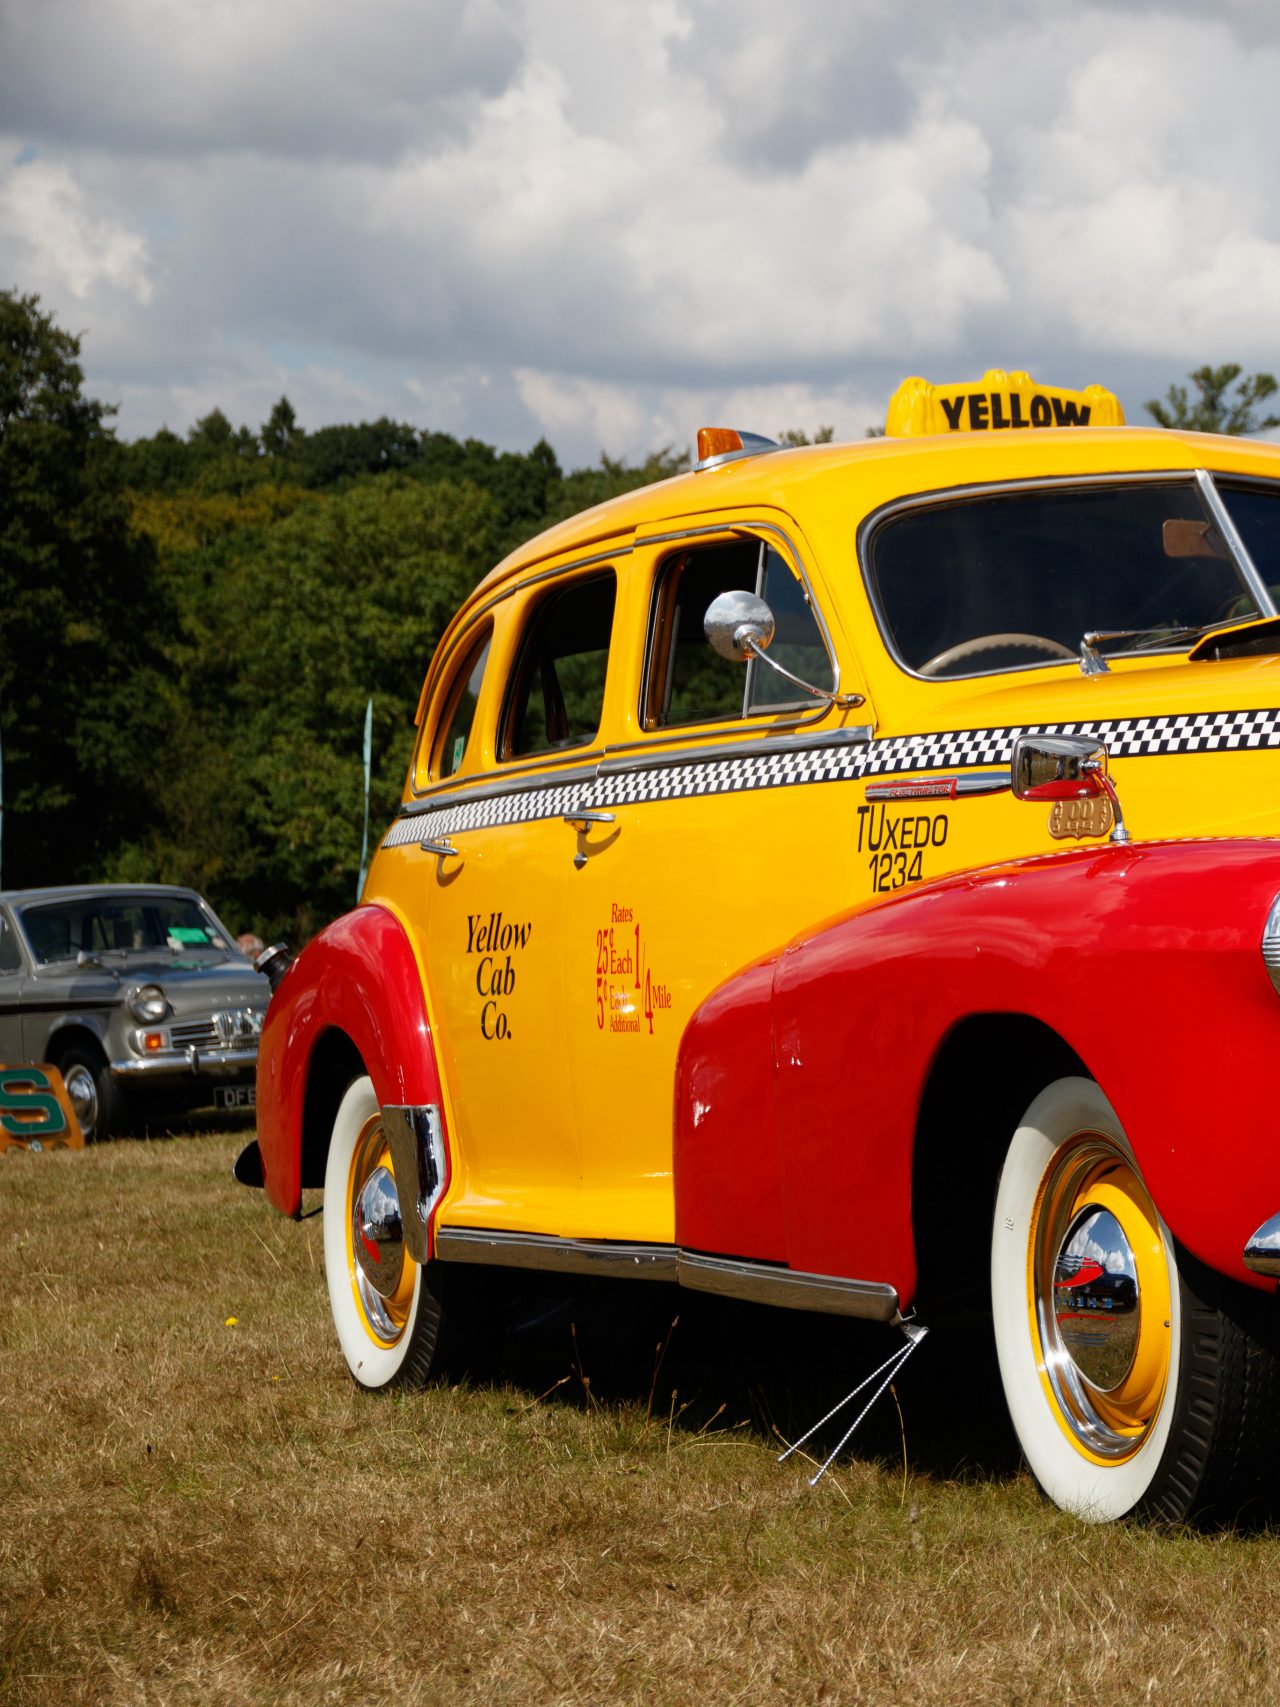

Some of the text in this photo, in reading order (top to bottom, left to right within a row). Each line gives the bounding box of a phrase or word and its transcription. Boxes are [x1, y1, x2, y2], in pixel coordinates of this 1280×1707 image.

[940, 393, 1091, 430] YELLOW
[857, 804, 948, 852] TUXEDO
[868, 851, 923, 892] 1234
[611, 903, 633, 923] Rates
[466, 912, 531, 953] Yellow
[476, 956, 515, 996] Cab
[610, 949, 632, 974] Each
[652, 985, 671, 1008] Mile
[481, 1001, 512, 1040] Co.
[609, 1014, 641, 1032] Additional
